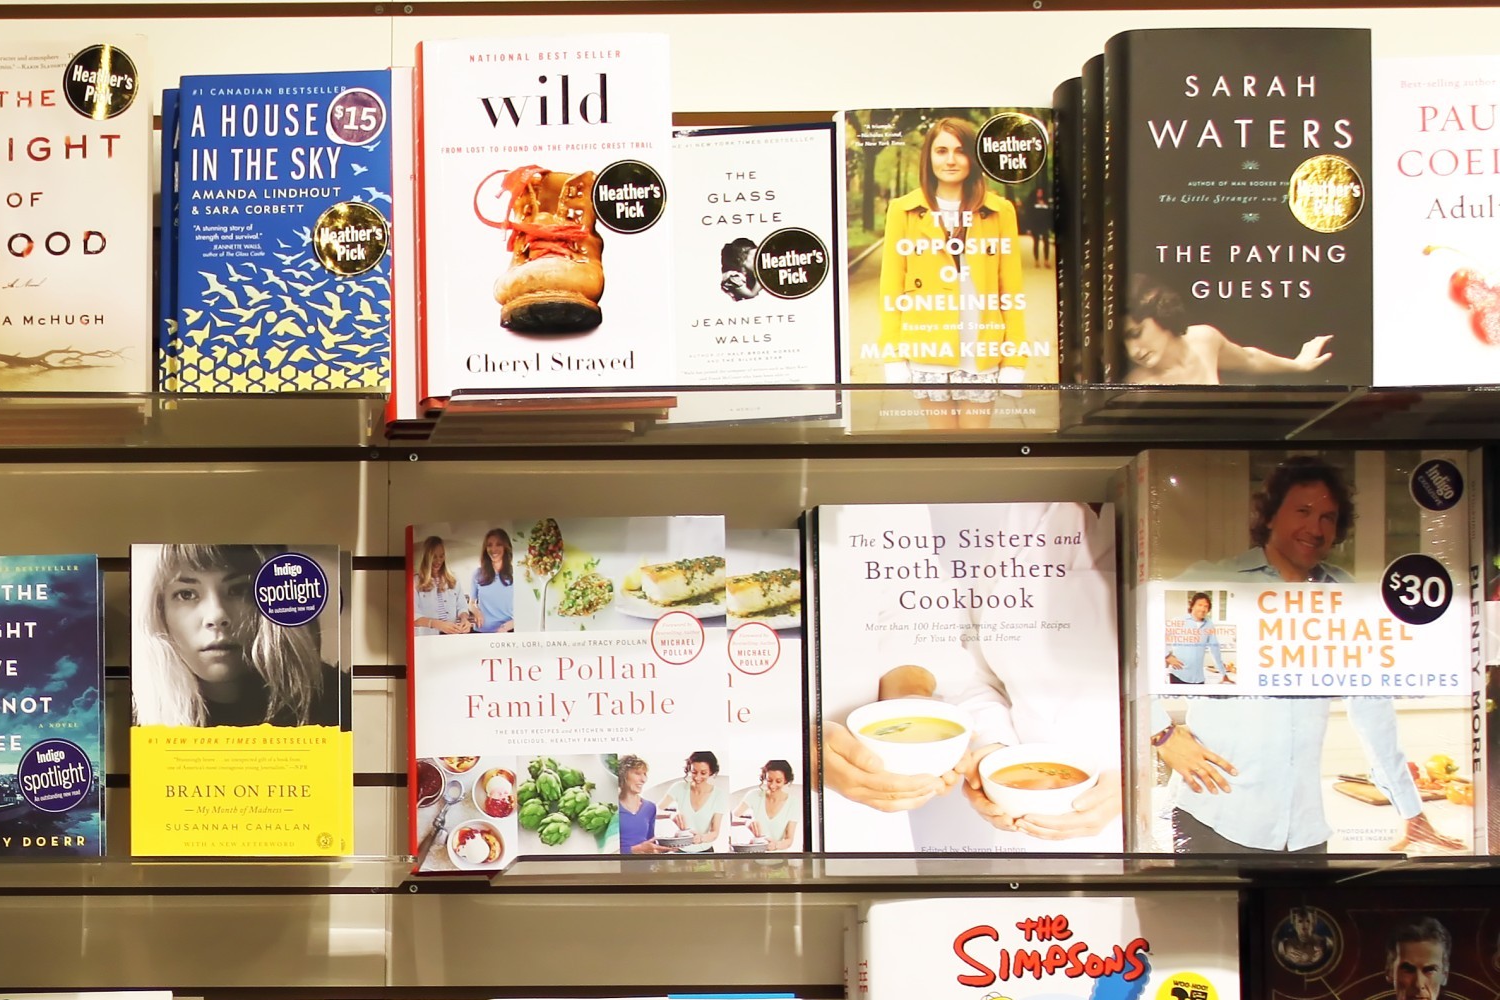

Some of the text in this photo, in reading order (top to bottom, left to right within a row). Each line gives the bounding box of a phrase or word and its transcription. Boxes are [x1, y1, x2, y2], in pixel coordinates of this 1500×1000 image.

[470, 50, 621, 62] NATIONAL BEST SELLER
[1184, 76, 1317, 98] SARAH
[478, 73, 612, 128] wild
[191, 105, 318, 137] A HOUSE
[1148, 120, 1353, 150] WATERS
[192, 187, 341, 199] AMANDA LINDHOUT
[707, 191, 776, 204] GLASS
[701, 211, 782, 225] CASTLE
[884, 293, 1026, 312] LONELINESS
[23, 315, 104, 326] McHUGH
[466, 352, 635, 377] Cheryl Strayed
[865, 558, 1066, 580] Broth Brothers
[899, 589, 1034, 611] Cookbook
[1389, 573, 1447, 608] $30
[661, 638, 695, 647] MICHAEL
[663, 648, 693, 657] POLLAN
[1471, 565, 1481, 774] PLENTY MORE
[1259, 673, 1458, 687] BEST LOVED RECIPES
[465, 689, 676, 723] Family Table
[165, 784, 311, 798] BRAIN ON FIRE
[166, 822, 311, 831] SUSANNAH CAHALAN
[22, 835, 85, 848] DOERR
[953, 924, 1150, 987] SIMPSONS
